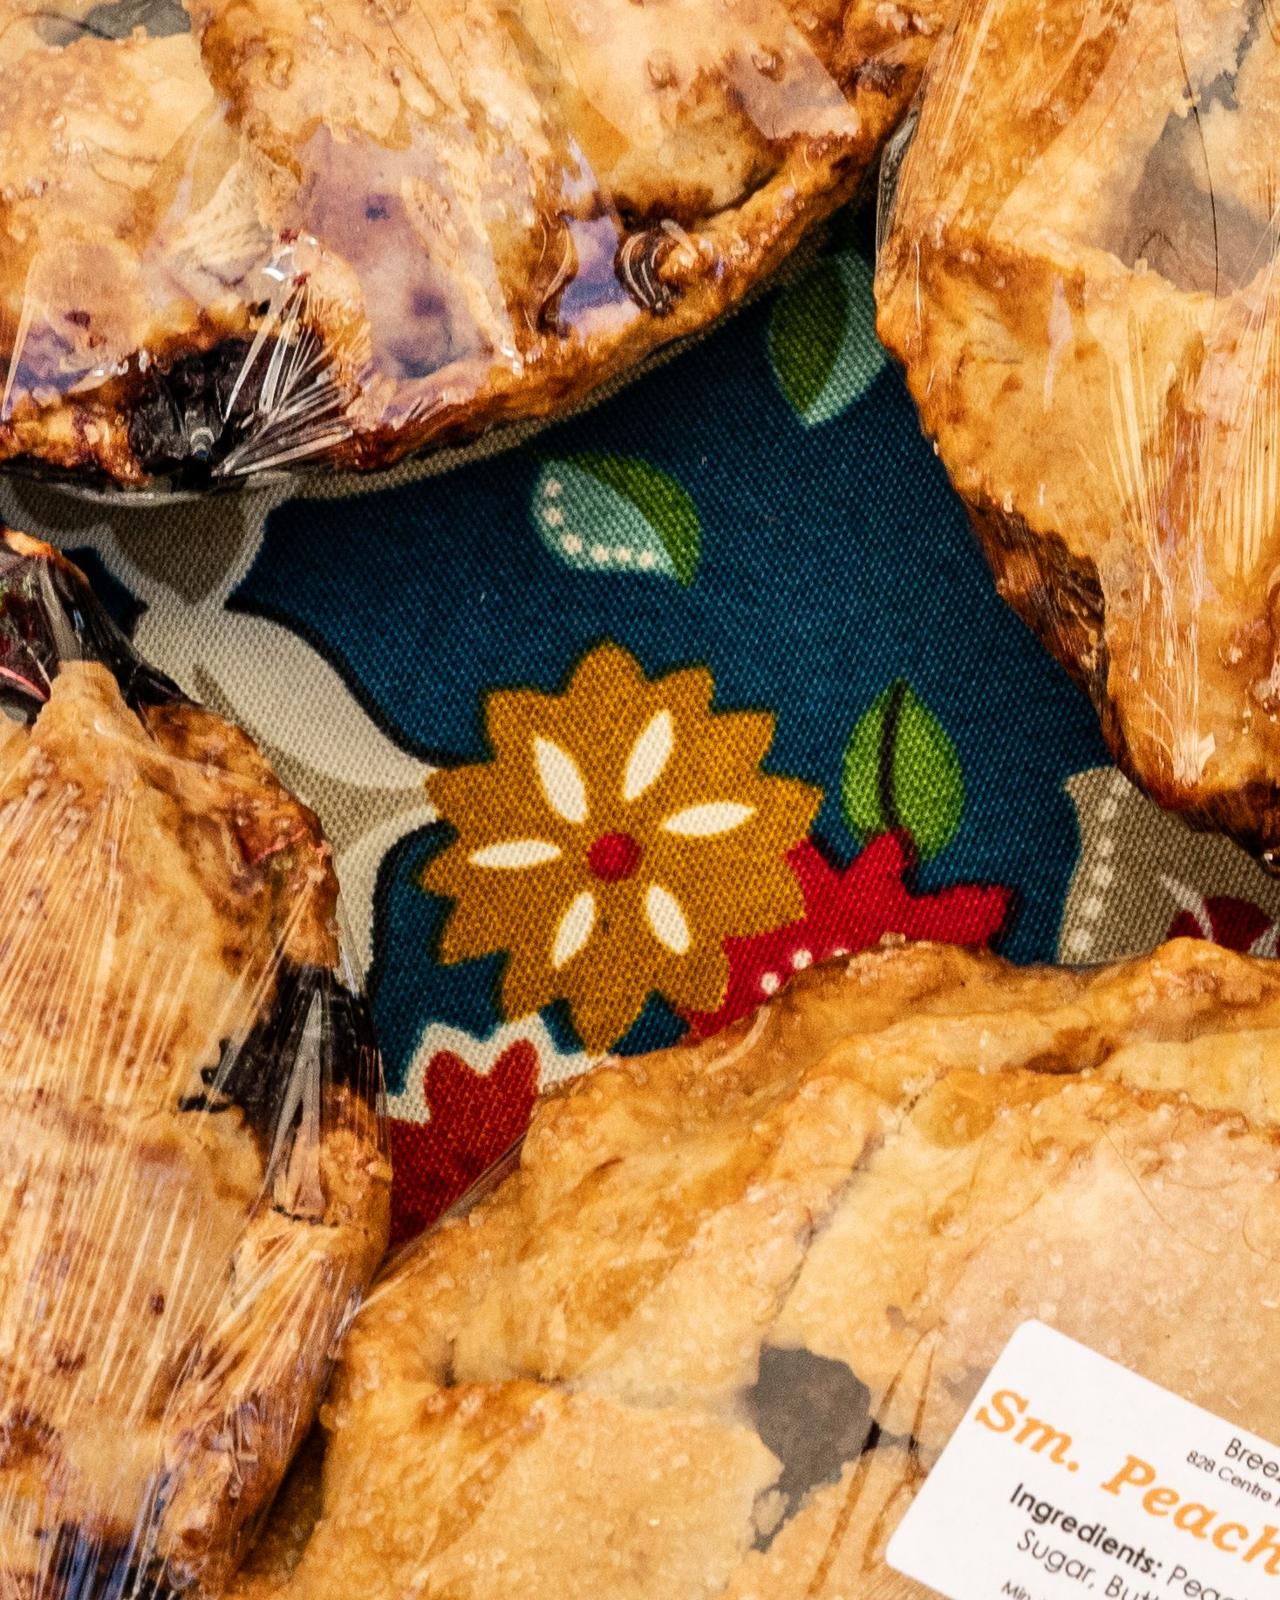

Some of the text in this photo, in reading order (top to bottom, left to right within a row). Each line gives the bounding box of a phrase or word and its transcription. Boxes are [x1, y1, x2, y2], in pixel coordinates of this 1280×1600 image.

[974, 1388, 1080, 1473] Sm.
[1186, 1450, 1217, 1473] 828
[1217, 1466, 1273, 1502] Centre
[1009, 1482, 1163, 1579] Ingredients:
[1017, 1529, 1096, 1589] Sugar,
